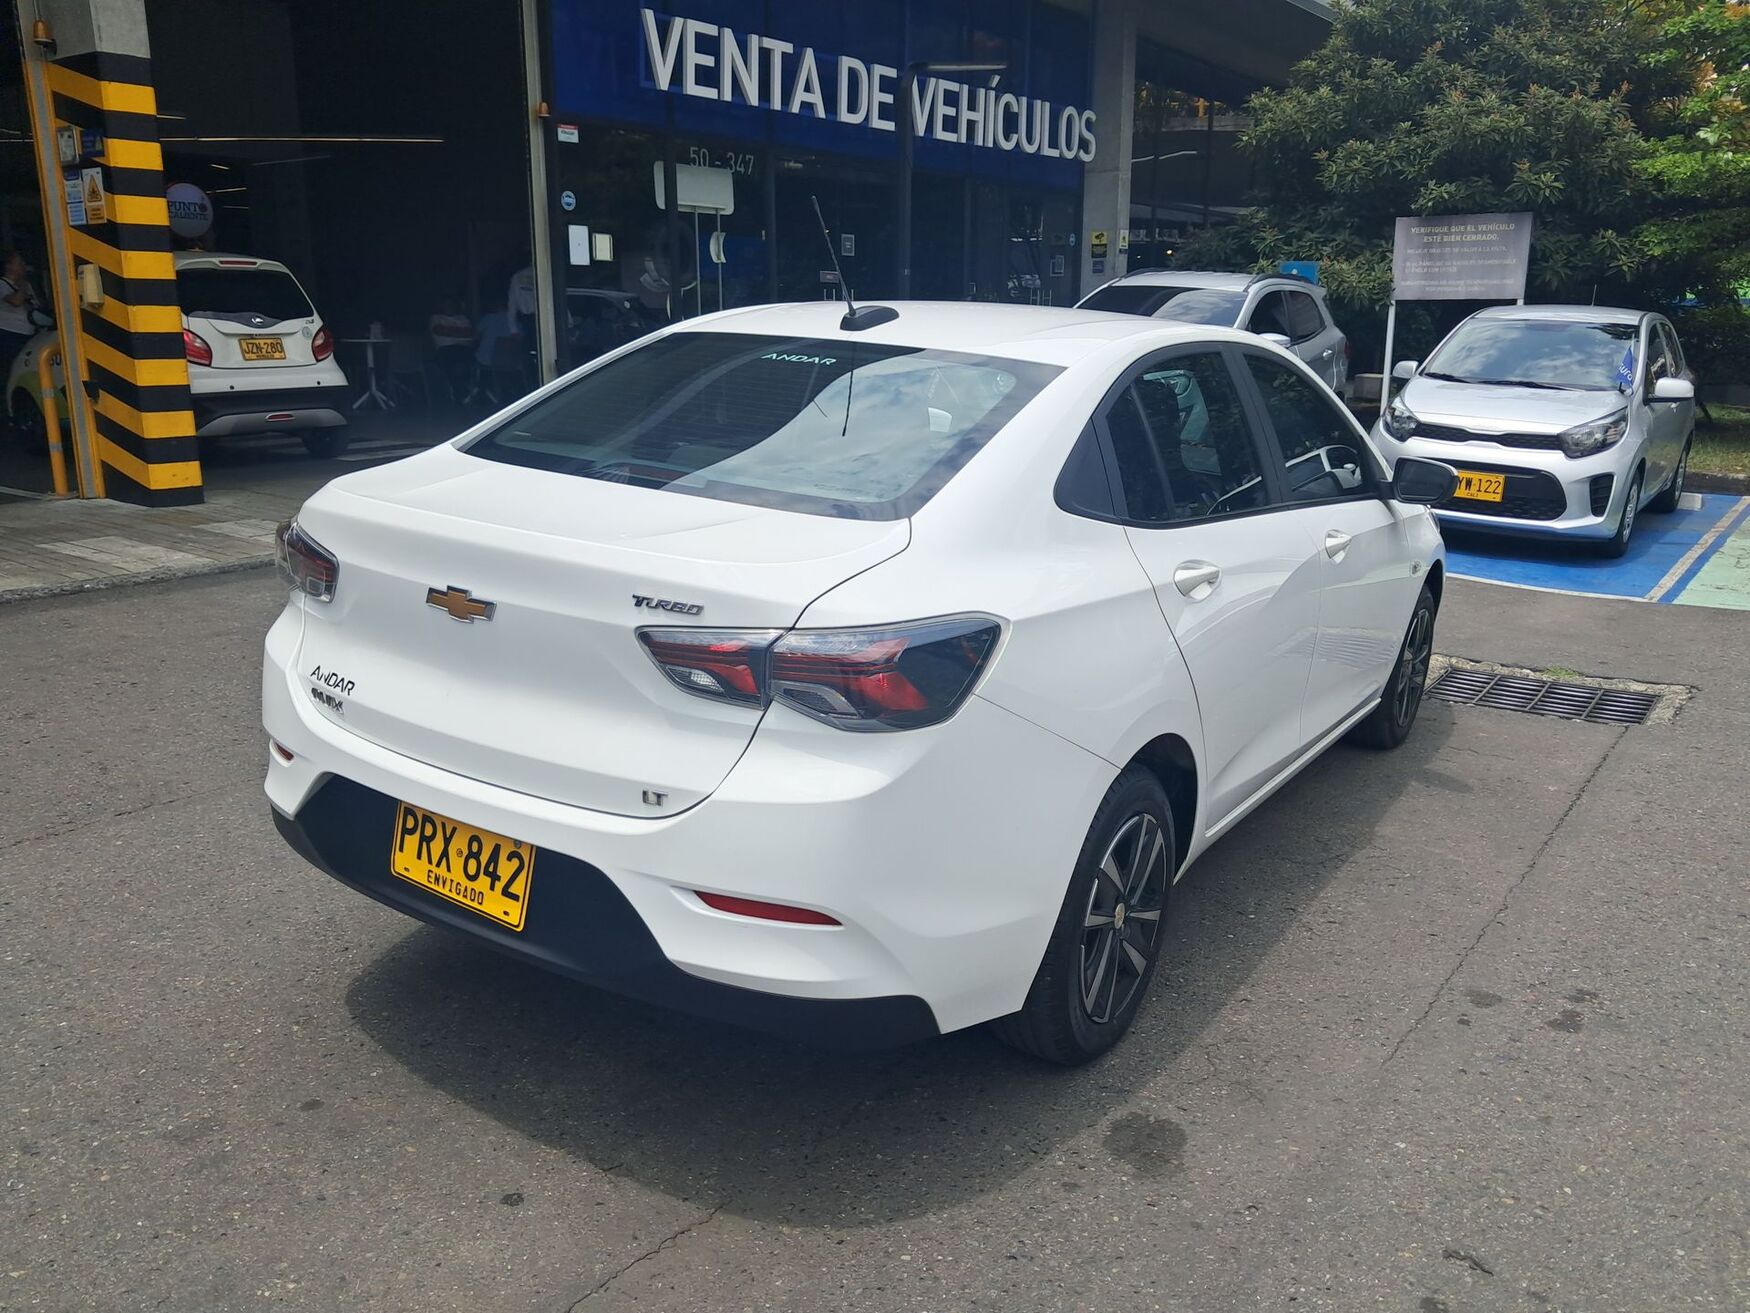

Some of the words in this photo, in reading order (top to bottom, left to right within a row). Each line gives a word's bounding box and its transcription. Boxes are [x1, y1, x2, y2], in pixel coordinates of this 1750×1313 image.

[640, 8, 826, 119] VENTA
[836, 55, 898, 132] DE
[912, 74, 1097, 163] VEHÍCULOS
[690, 146, 709, 168] 50
[727, 151, 754, 175] 347
[1410, 225, 1449, 234] VERIFIQUE
[1450, 224, 1465, 232] QUE
[761, 353, 837, 365] ANDAR
[1476, 478, 1501, 494] 122
[632, 593, 704, 616] TURBO
[310, 665, 355, 696] ANDAR
[642, 789, 669, 807] LT
[399, 806, 457, 874] PRX
[463, 834, 525, 903] 842
[426, 868, 485, 906] ENVIGADO
